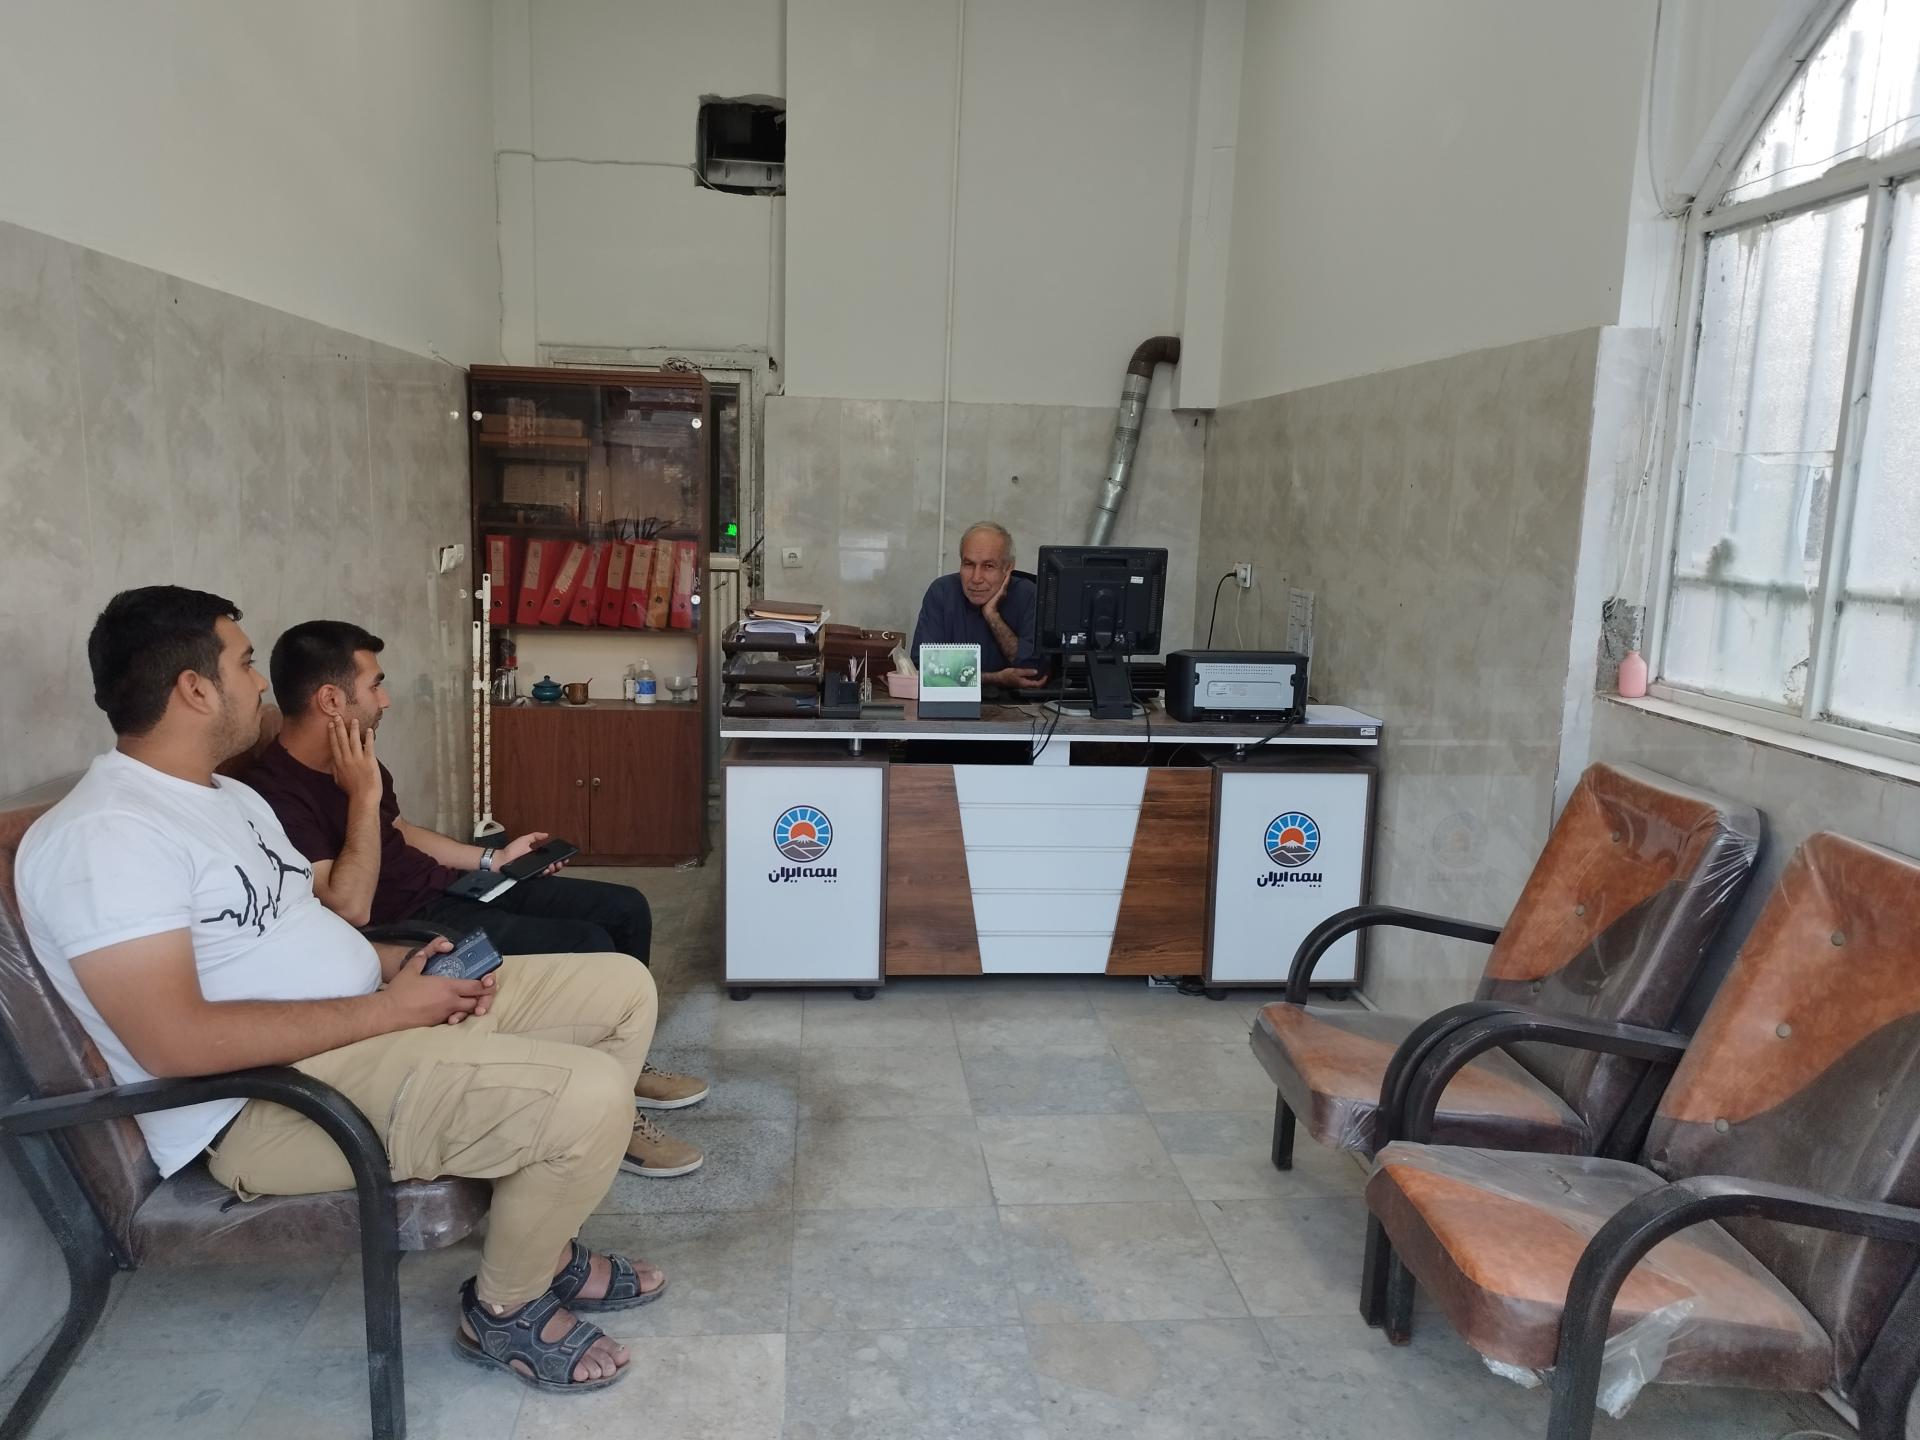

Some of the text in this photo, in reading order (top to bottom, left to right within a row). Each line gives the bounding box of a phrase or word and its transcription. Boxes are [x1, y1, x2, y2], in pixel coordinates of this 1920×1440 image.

[768, 866, 837, 883] بیمه ایران
[1256, 871, 1322, 887] بیمه ایران
